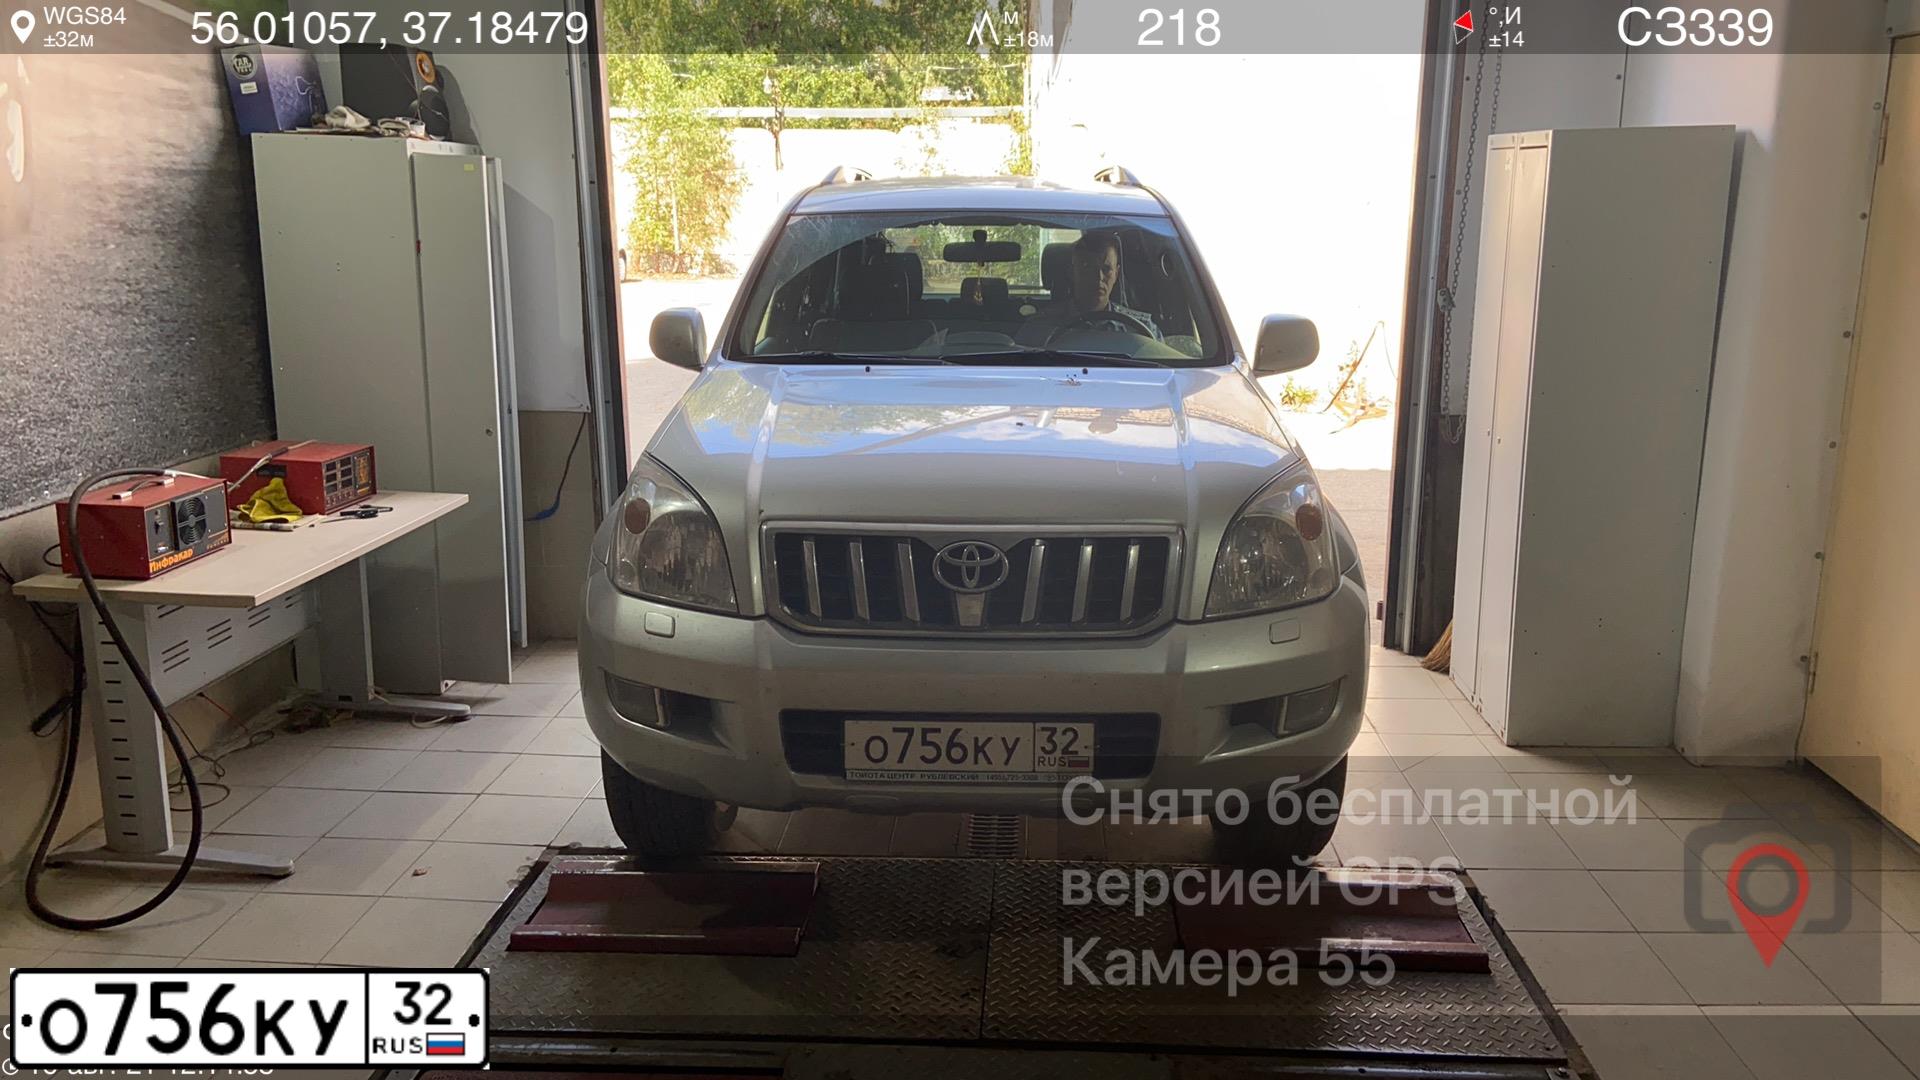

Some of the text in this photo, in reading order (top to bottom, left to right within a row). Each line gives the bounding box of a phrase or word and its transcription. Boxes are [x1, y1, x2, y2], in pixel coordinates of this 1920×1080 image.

[864, 726, 1080, 766] О756КУ 32
[1037, 756, 1067, 767] RUS
